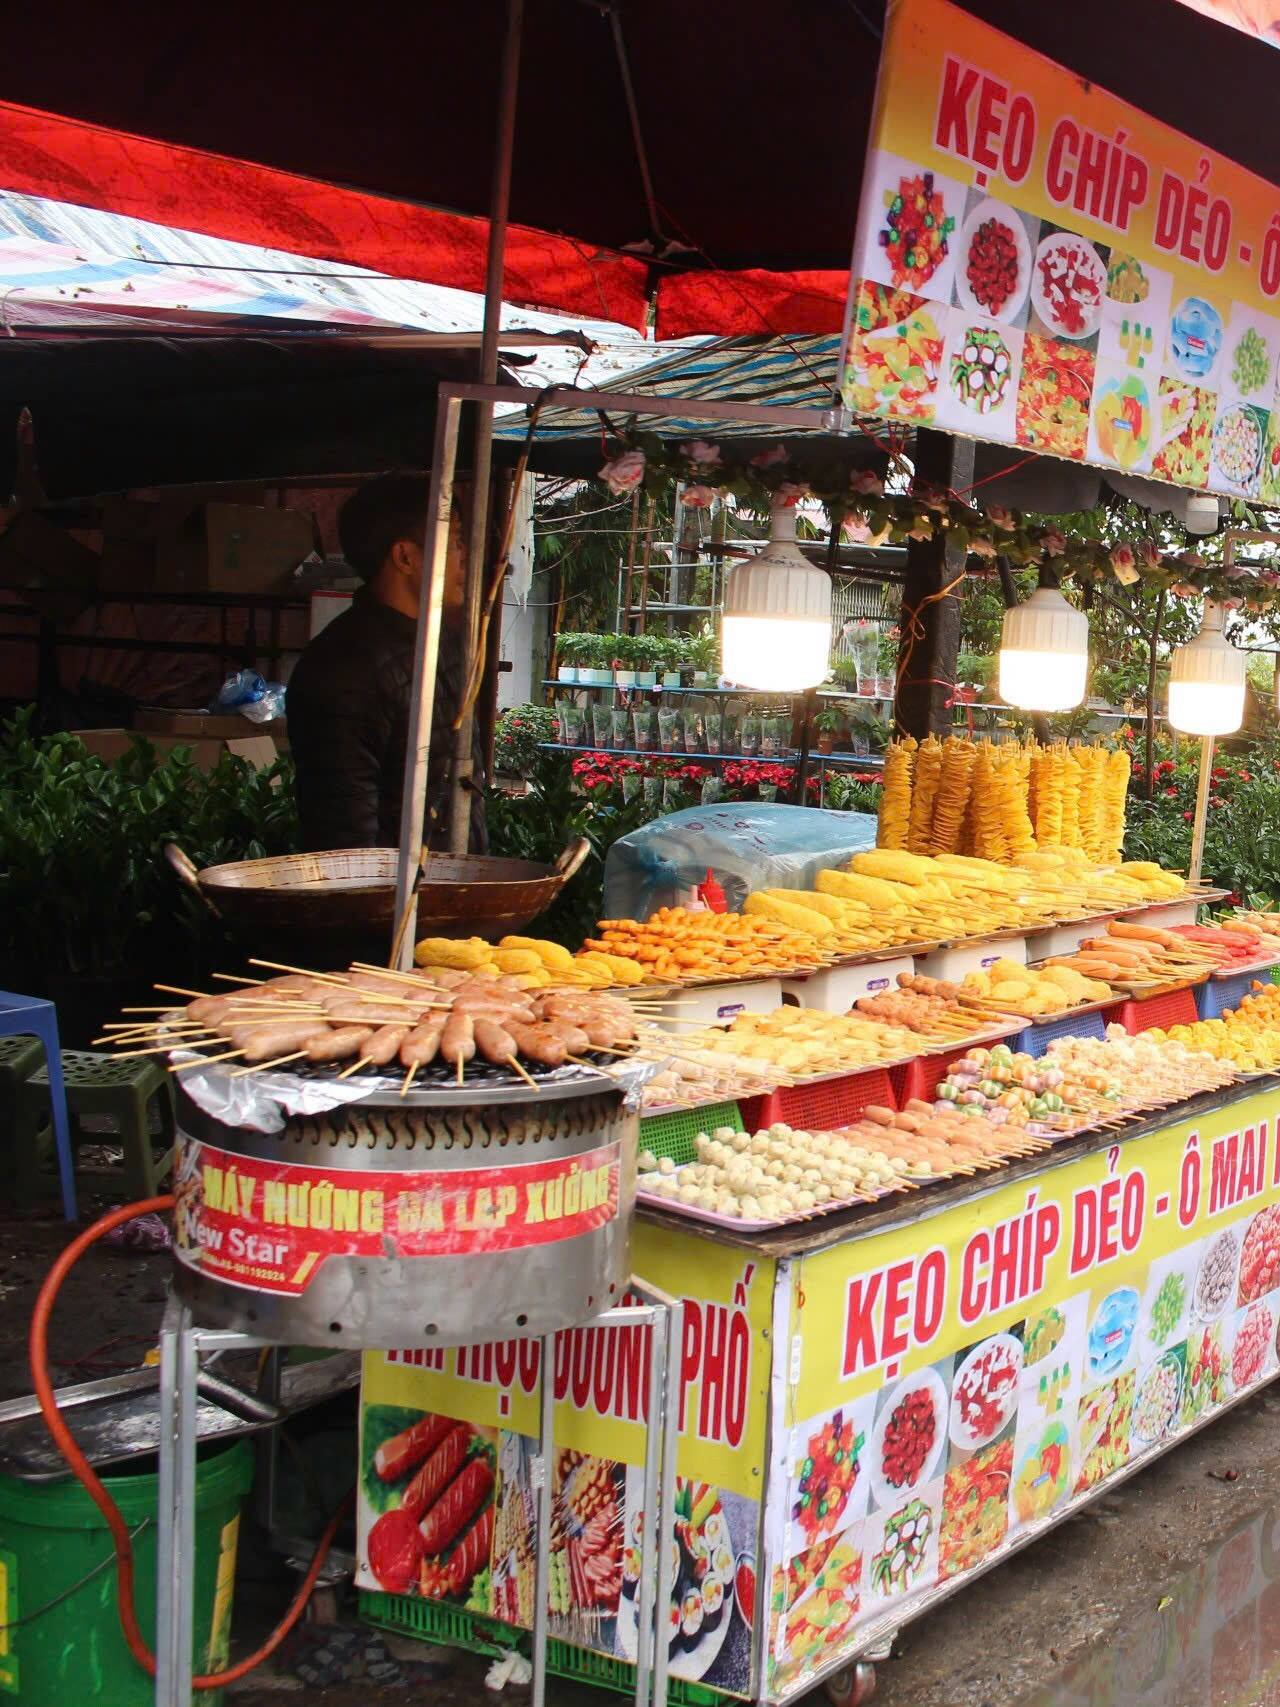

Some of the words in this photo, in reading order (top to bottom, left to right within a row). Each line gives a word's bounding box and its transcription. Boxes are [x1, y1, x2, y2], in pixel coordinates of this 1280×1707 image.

[936, 58, 1035, 187] KẸO
[1047, 119, 1148, 230] CHÍP
[1155, 159, 1231, 271] DẺO
[185, 1206, 223, 1250] New
[229, 1227, 289, 1265] Star
[263, 1179, 385, 1233] NƯỚNG
[843, 1250, 945, 1379] KẸO
[960, 1192, 1060, 1323] CHÍP
[1071, 1146, 1145, 1274] DẺO
[1179, 1134, 1200, 1226] Ô
[1209, 1124, 1267, 1214] MAI
[677, 1264, 755, 1447] PHỐ
